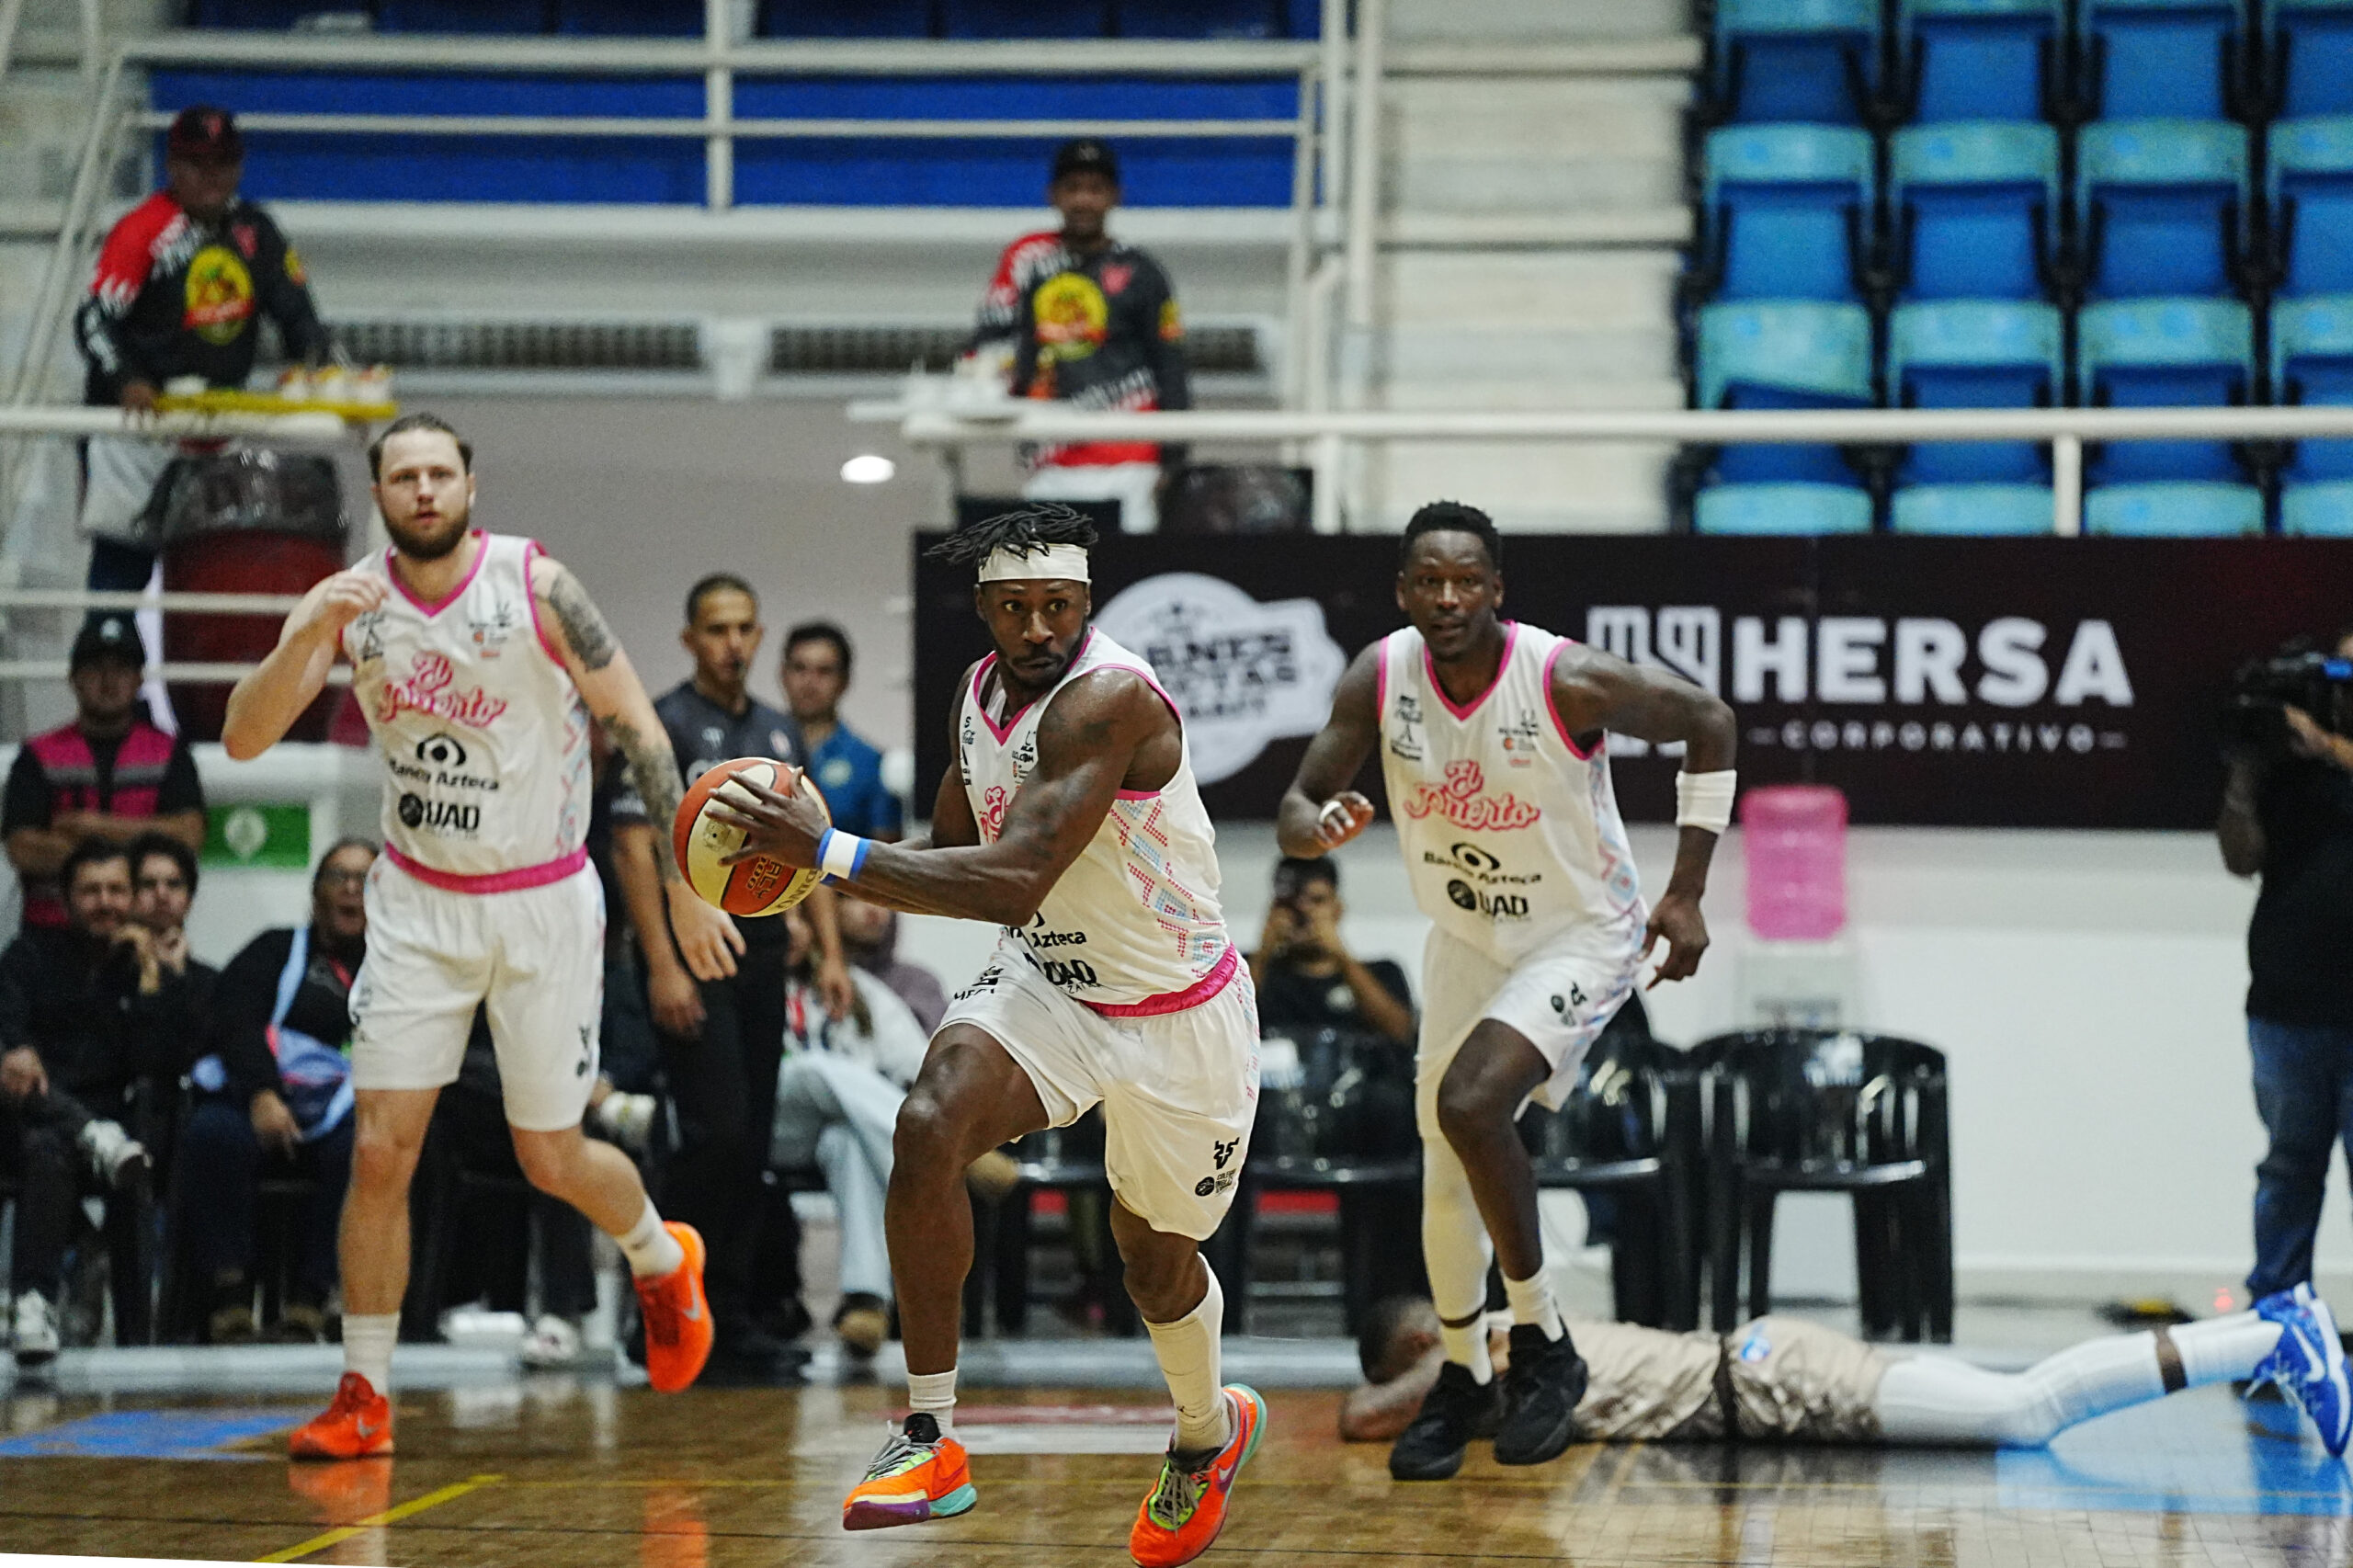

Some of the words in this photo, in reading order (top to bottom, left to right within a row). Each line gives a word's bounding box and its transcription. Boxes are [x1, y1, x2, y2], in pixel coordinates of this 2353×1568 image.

[1732, 616, 2135, 707] HERSA
[1781, 720, 2095, 754] CORPORATIVO
[1403, 781, 1541, 831] Puerto
[1031, 931, 1086, 949] Azteca
